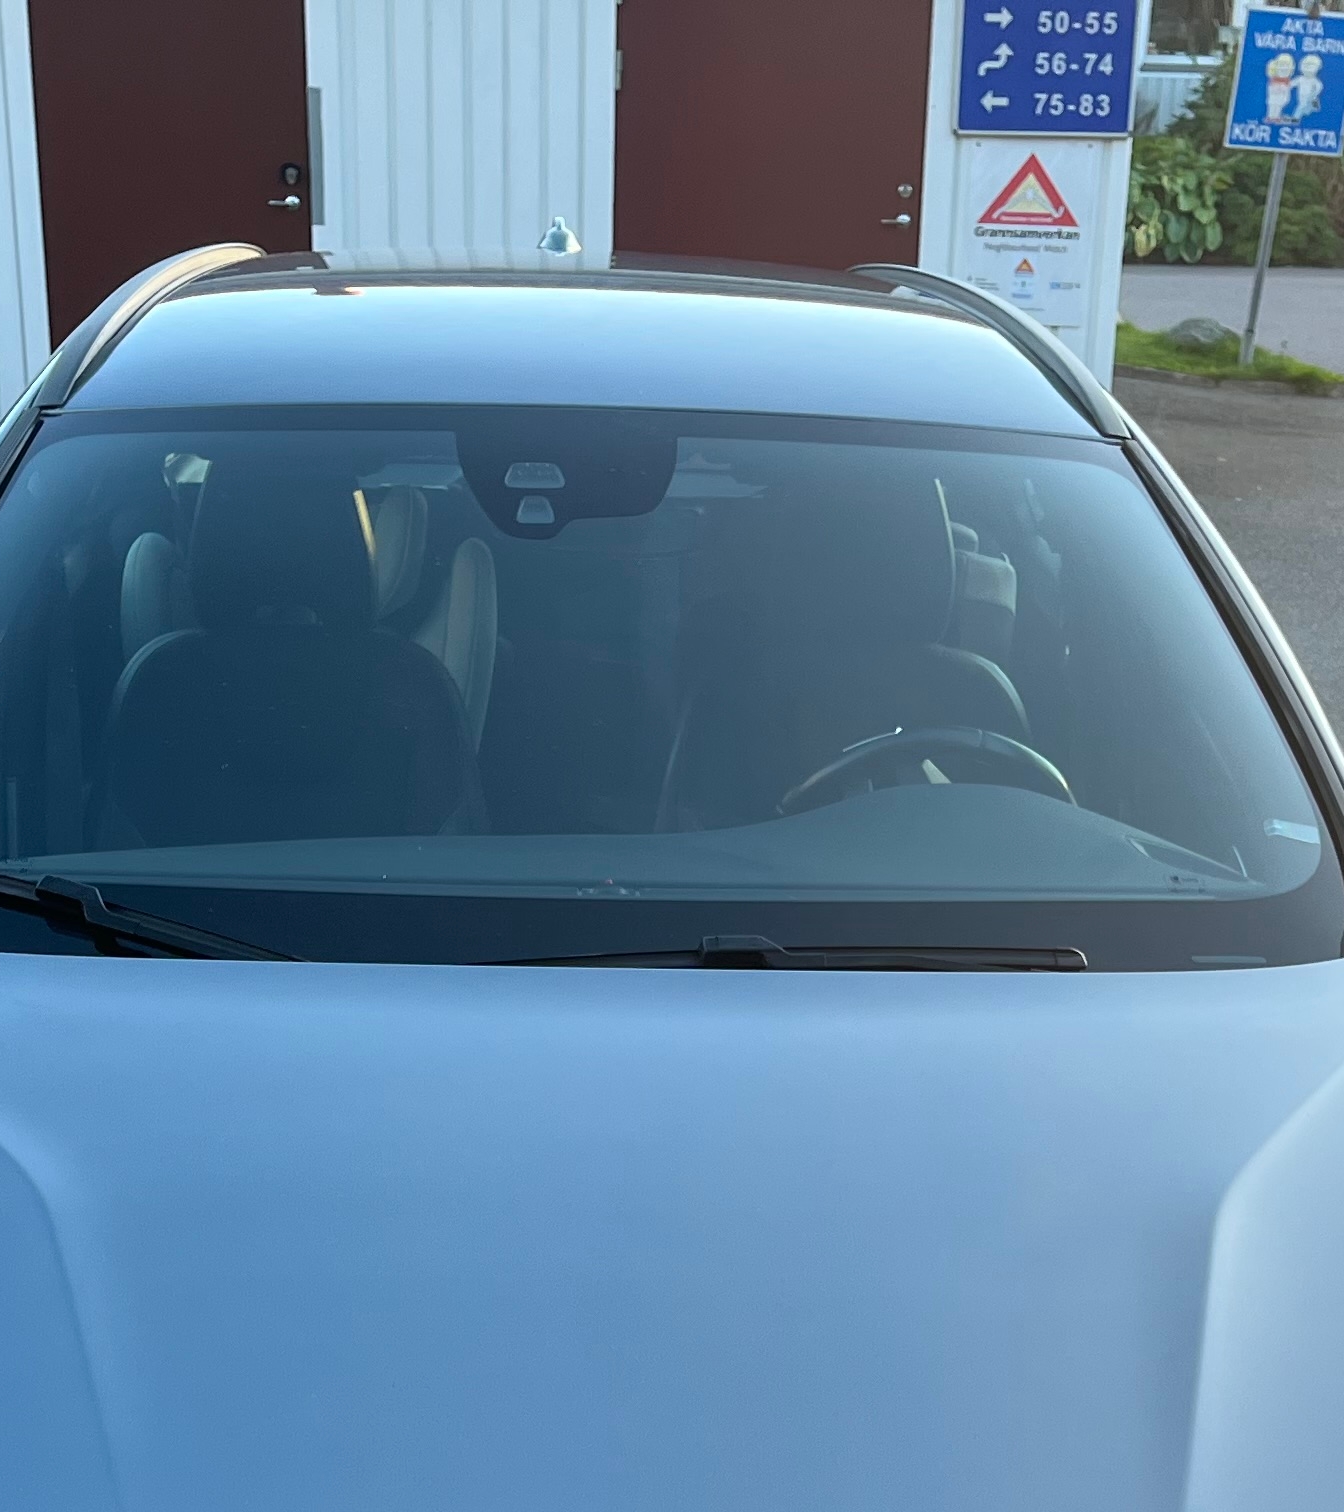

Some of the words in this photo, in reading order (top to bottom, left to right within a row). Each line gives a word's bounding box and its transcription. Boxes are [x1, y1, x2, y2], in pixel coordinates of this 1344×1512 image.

[1037, 10, 1118, 35] 50-55
[1281, 17, 1324, 36] AKTA
[1254, 30, 1296, 50] VÅRA
[1034, 51, 1114, 76] 56-74
[1033, 92, 1111, 117] 75-83
[1231, 119, 1271, 143] KÖR
[1278, 126, 1336, 148] SAKTA
